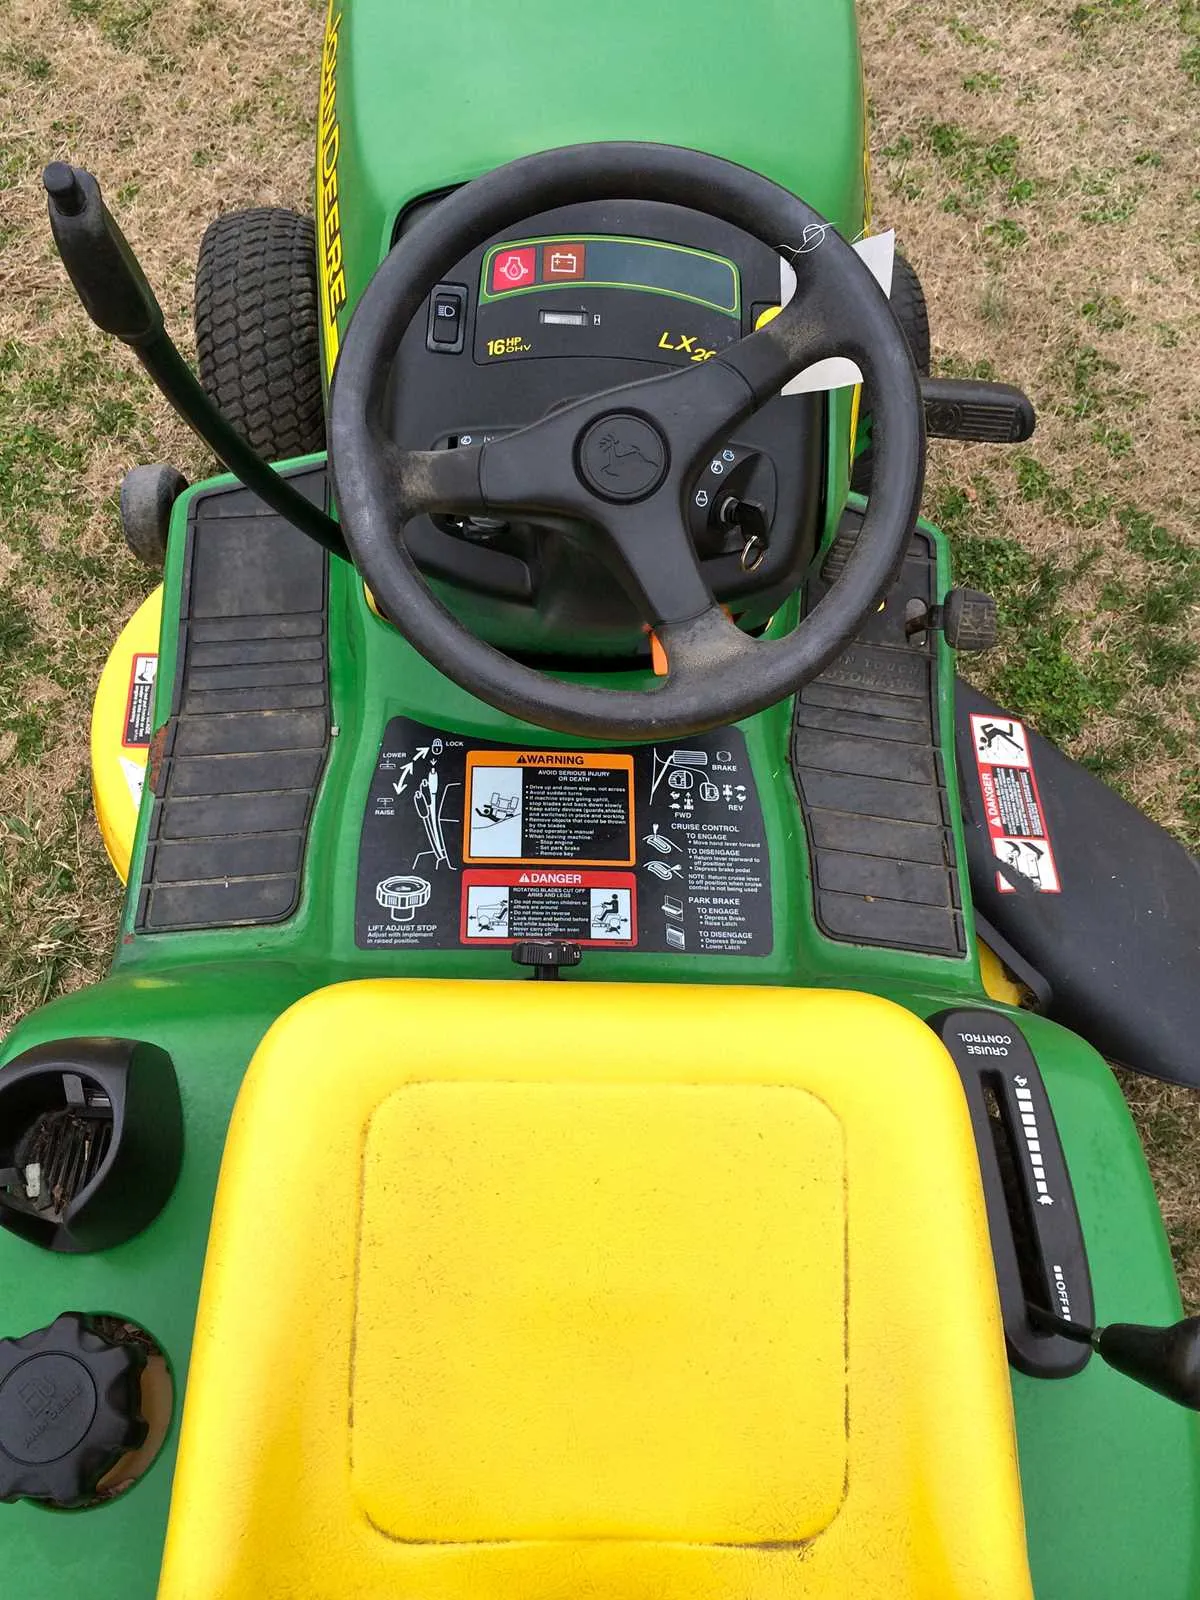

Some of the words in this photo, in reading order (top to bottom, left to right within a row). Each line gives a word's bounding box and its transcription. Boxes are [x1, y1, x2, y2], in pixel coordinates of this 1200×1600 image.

[322, 124, 347, 327] DEERE
[488, 339, 505, 356] 16
[506, 337, 522, 346] HP
[506, 344, 532, 352] OHV
[527, 755, 584, 765] WARNING
[982, 772, 999, 818] DANGER
[670, 822, 700, 830] CRUISE
[701, 824, 740, 832] CONTROL
[531, 873, 582, 884] DANGER
[957, 1033, 1012, 1045] CONTROL
[966, 1045, 1008, 1056] CRUISE
[1056, 1280, 1070, 1306] OFF
